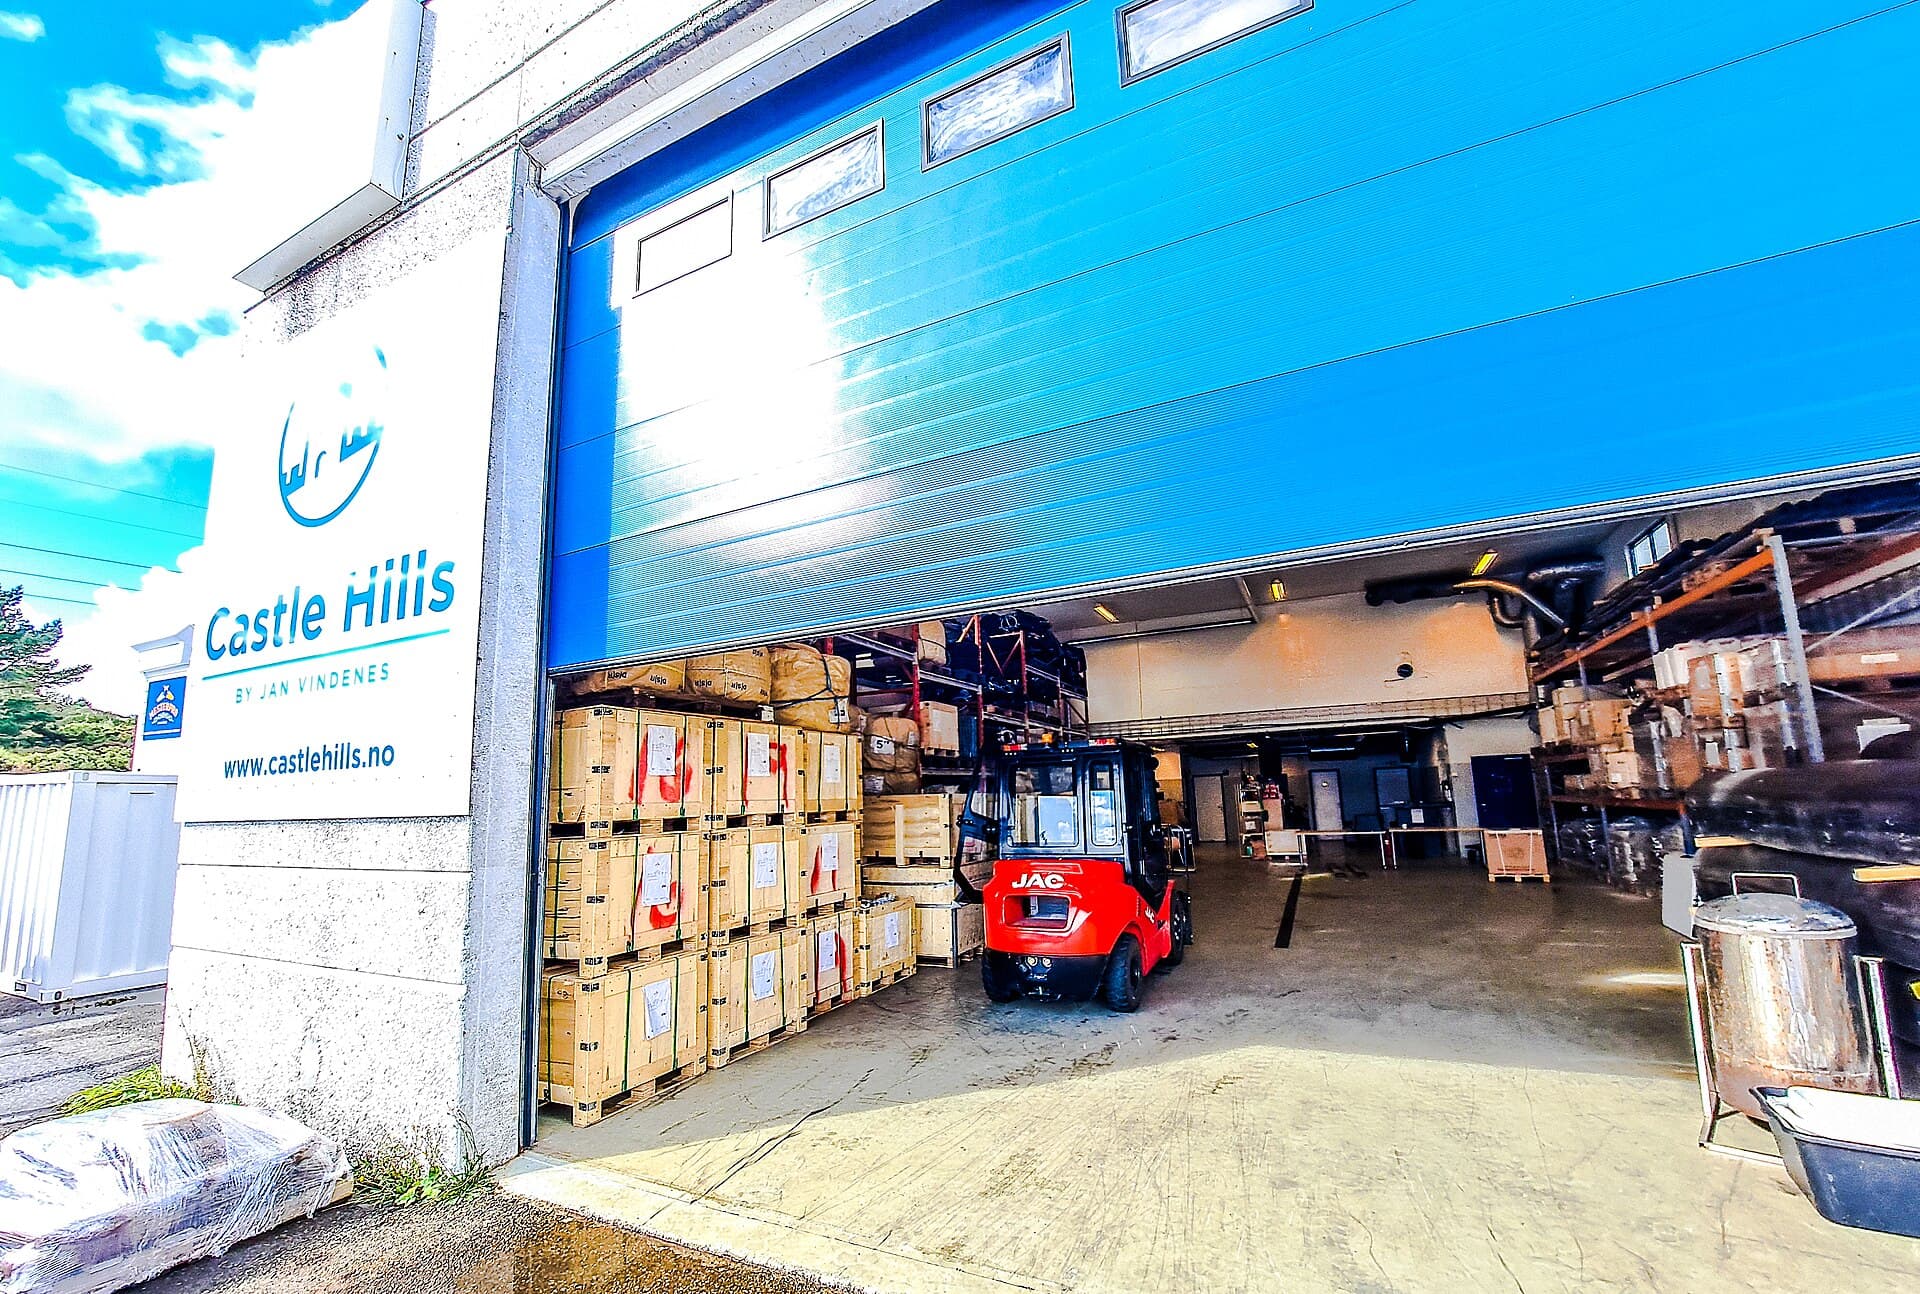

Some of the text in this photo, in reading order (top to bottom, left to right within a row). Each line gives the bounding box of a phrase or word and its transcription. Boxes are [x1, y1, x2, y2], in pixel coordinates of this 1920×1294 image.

[206, 549, 455, 661] Castle Hills
[235, 662, 389, 704] BY JAN VINDENES
[224, 742, 395, 779] www.castlehills.no
[1011, 872, 1065, 889] JAC
